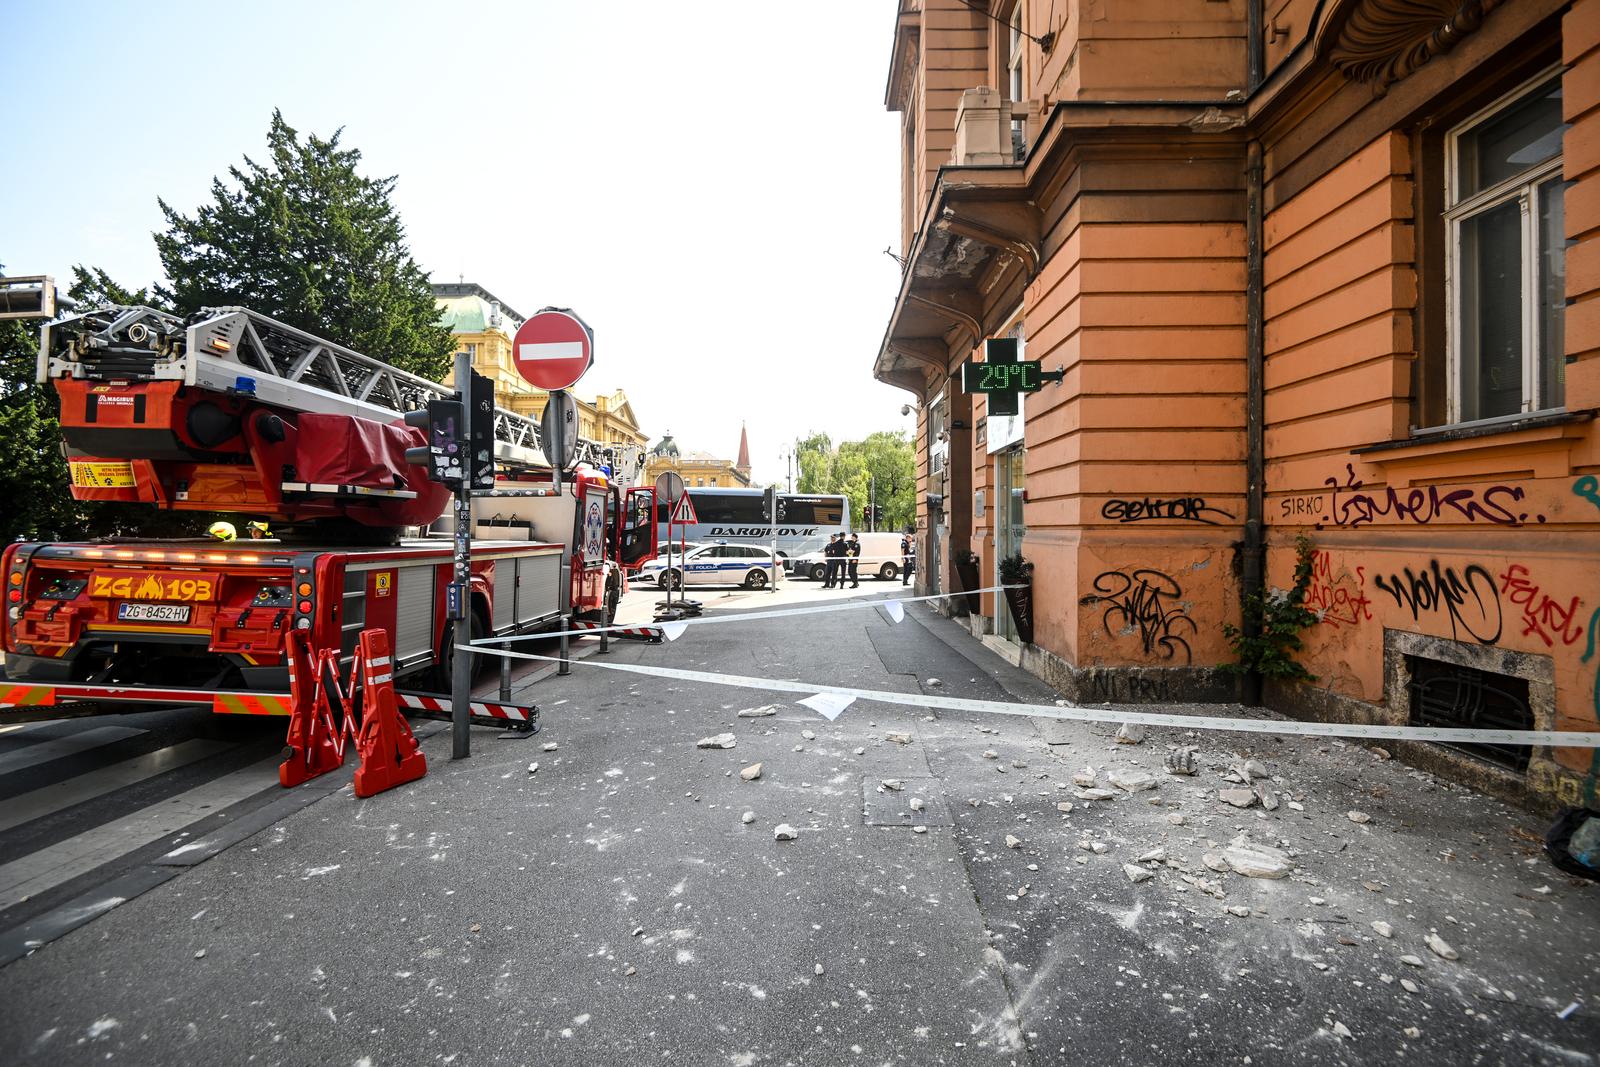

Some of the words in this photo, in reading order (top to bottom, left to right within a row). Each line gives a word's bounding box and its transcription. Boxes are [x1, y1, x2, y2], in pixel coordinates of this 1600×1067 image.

[979, 365, 1036, 389] 29°C
[94, 575, 133, 598] ZG
[167, 579, 211, 601] 193
[126, 605, 141, 618] ZG
